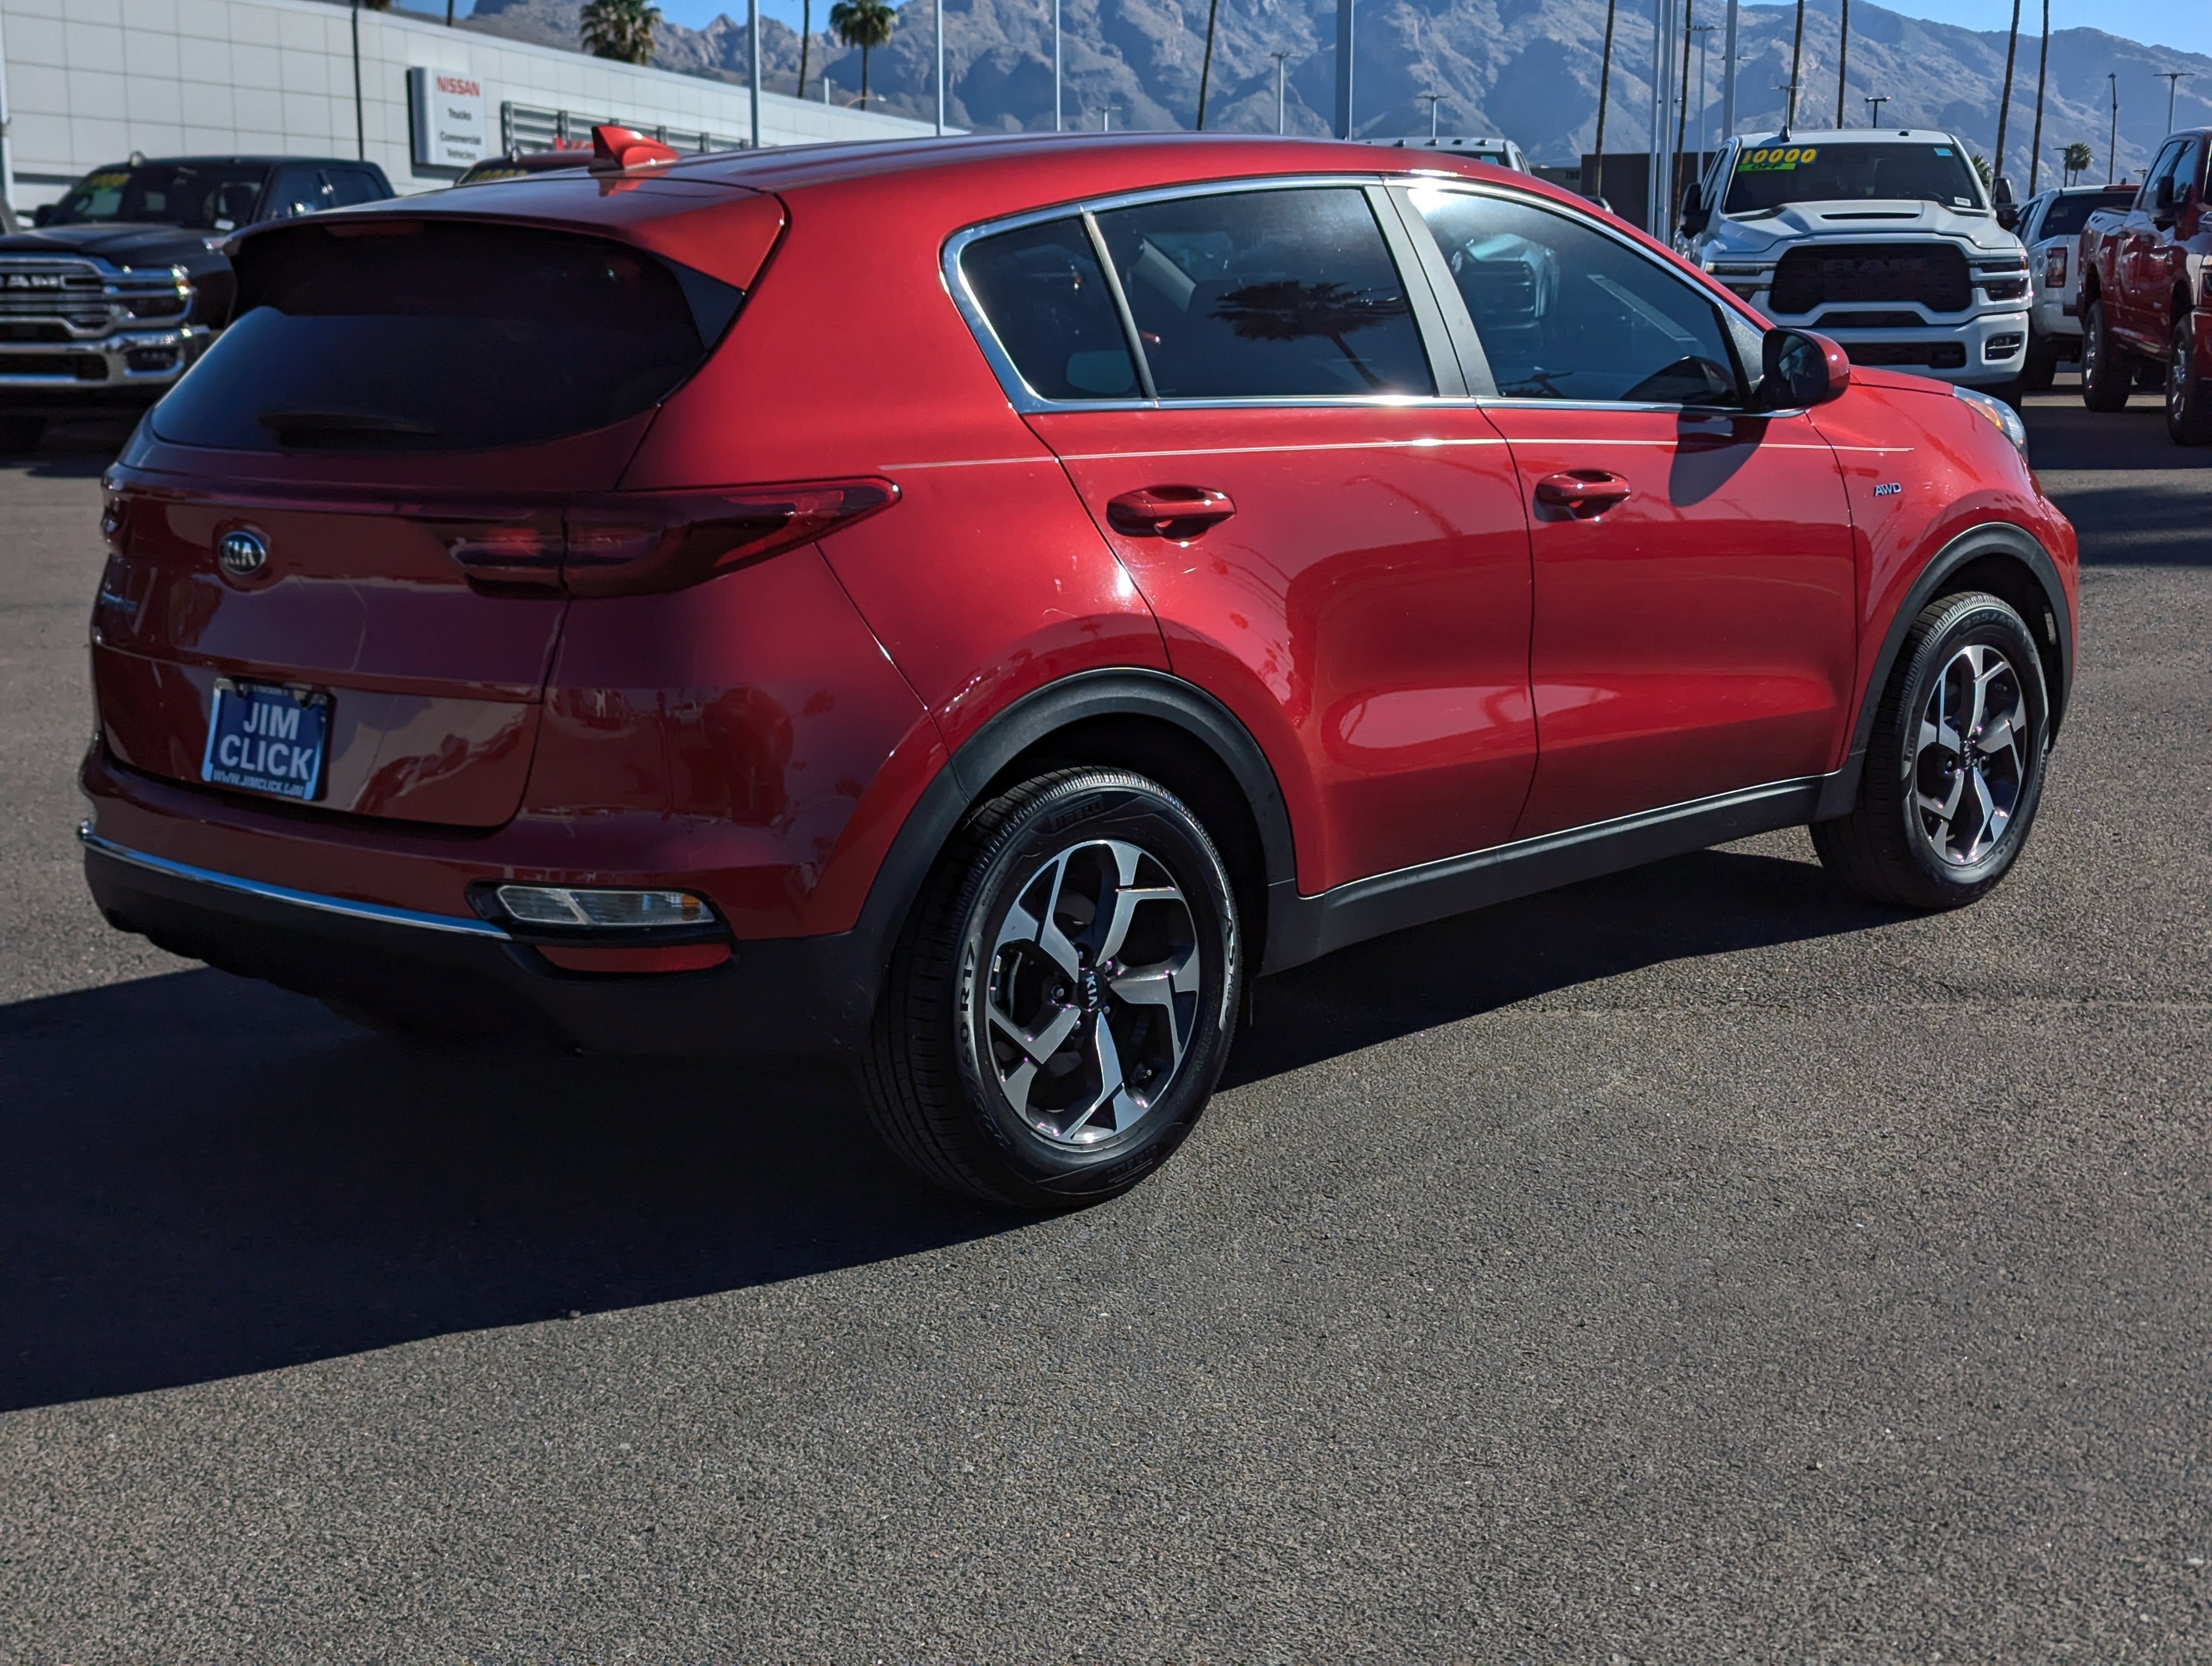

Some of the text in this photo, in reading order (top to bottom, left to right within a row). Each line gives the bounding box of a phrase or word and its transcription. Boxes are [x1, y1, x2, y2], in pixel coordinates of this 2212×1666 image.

[436, 76, 480, 98] NISSAN
[448, 108, 472, 121] Trucks
[440, 131, 482, 146] Commercial
[447, 148, 477, 160] Vehicles
[1741, 148, 1817, 164] 10000
[0, 275, 59, 289] AM
[1874, 482, 1902, 497] AWD
[223, 541, 256, 566] KIA
[243, 702, 300, 741] JIM
[220, 734, 314, 780] CLICK
[1085, 975, 1098, 1008] KIA
